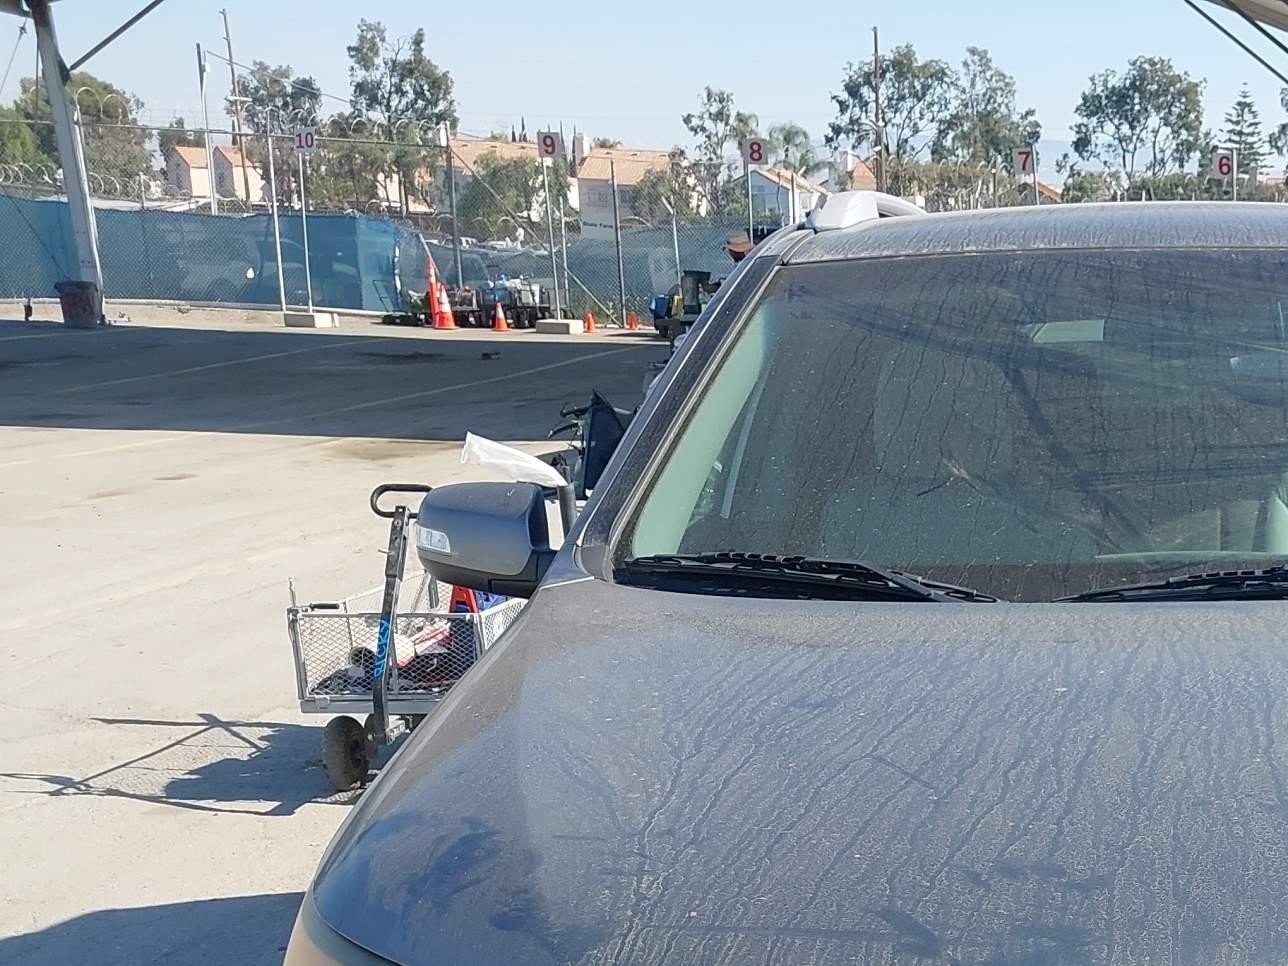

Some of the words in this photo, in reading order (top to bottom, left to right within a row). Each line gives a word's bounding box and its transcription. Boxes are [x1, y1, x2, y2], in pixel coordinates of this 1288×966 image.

[296, 131, 314, 149] 10
[543, 135, 555, 155] 9
[750, 142, 762, 161] 8
[1018, 151, 1030, 171] 7
[1219, 156, 1231, 175] 6
